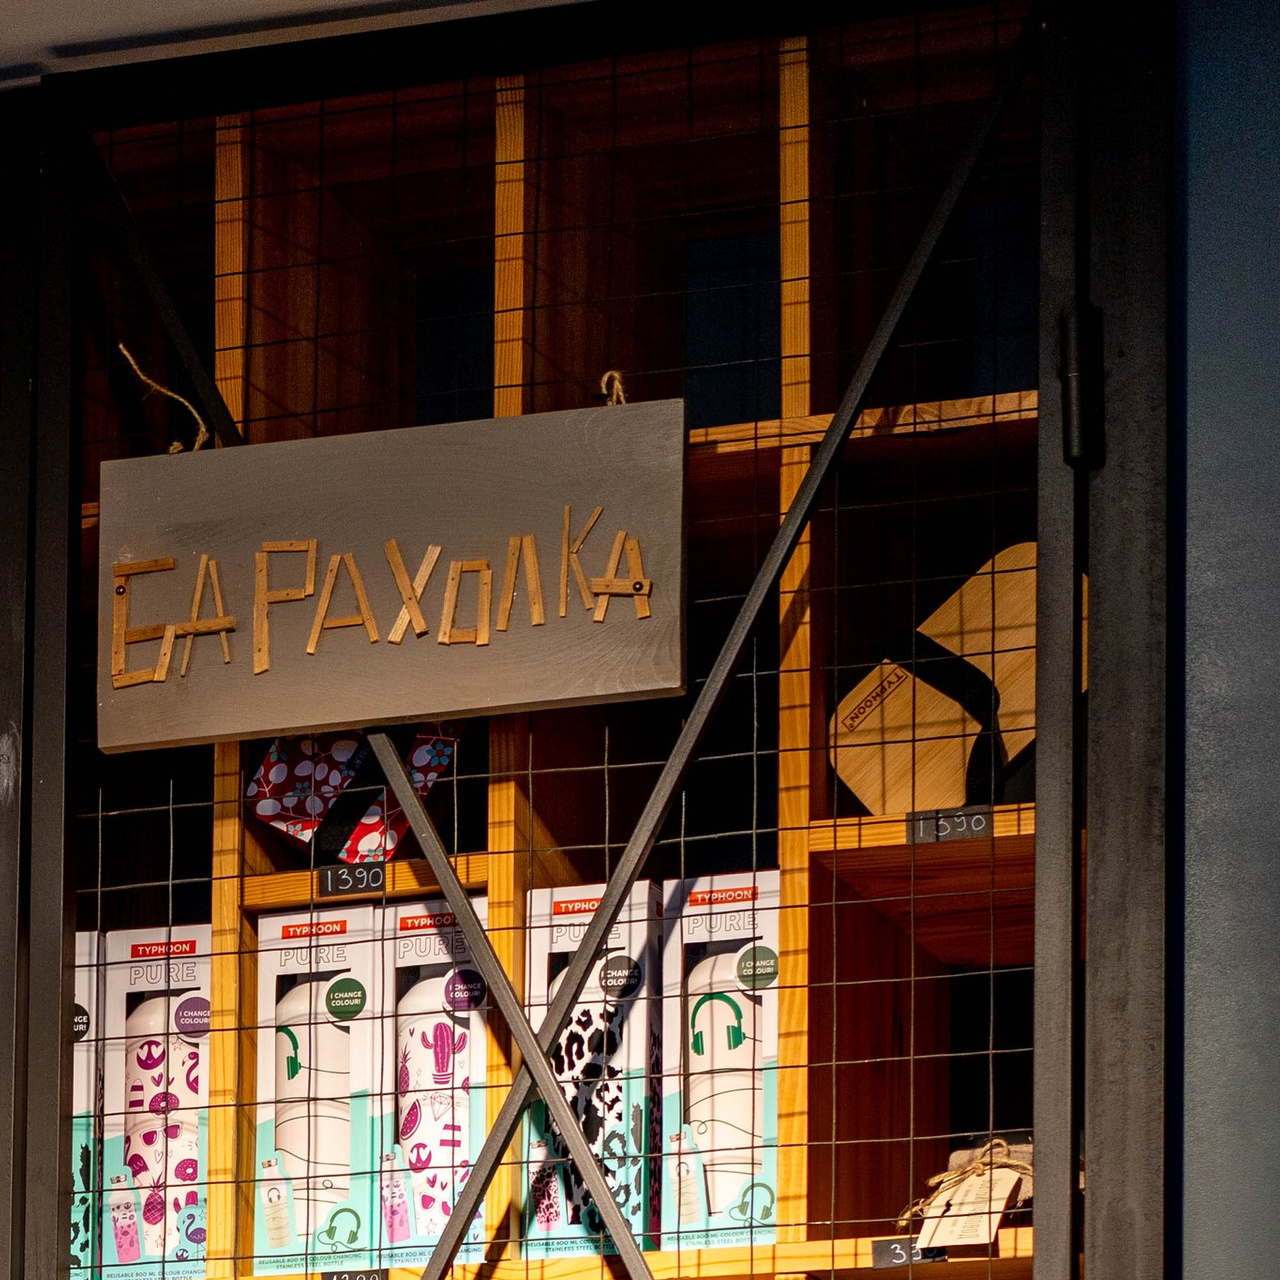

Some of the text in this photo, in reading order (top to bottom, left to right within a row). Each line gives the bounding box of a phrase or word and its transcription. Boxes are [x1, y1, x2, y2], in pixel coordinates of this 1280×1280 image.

[111, 504, 652, 690] БАРАХОЛКА
[849, 669, 906, 725] TYPHOON
[327, 867, 384, 892] 1390
[560, 901, 601, 913] TYPHO
[697, 890, 753, 903] TYPHOON
[288, 923, 341, 935] TYPHOON
[552, 918, 621, 944] PUE
[687, 910, 759, 935] PURE
[137, 943, 190, 956] TYPHOON
[280, 944, 347, 967] PURE
[398, 934, 467, 959] PURE
[129, 961, 197, 986] PURE
[334, 991, 362, 999] CHANGE
